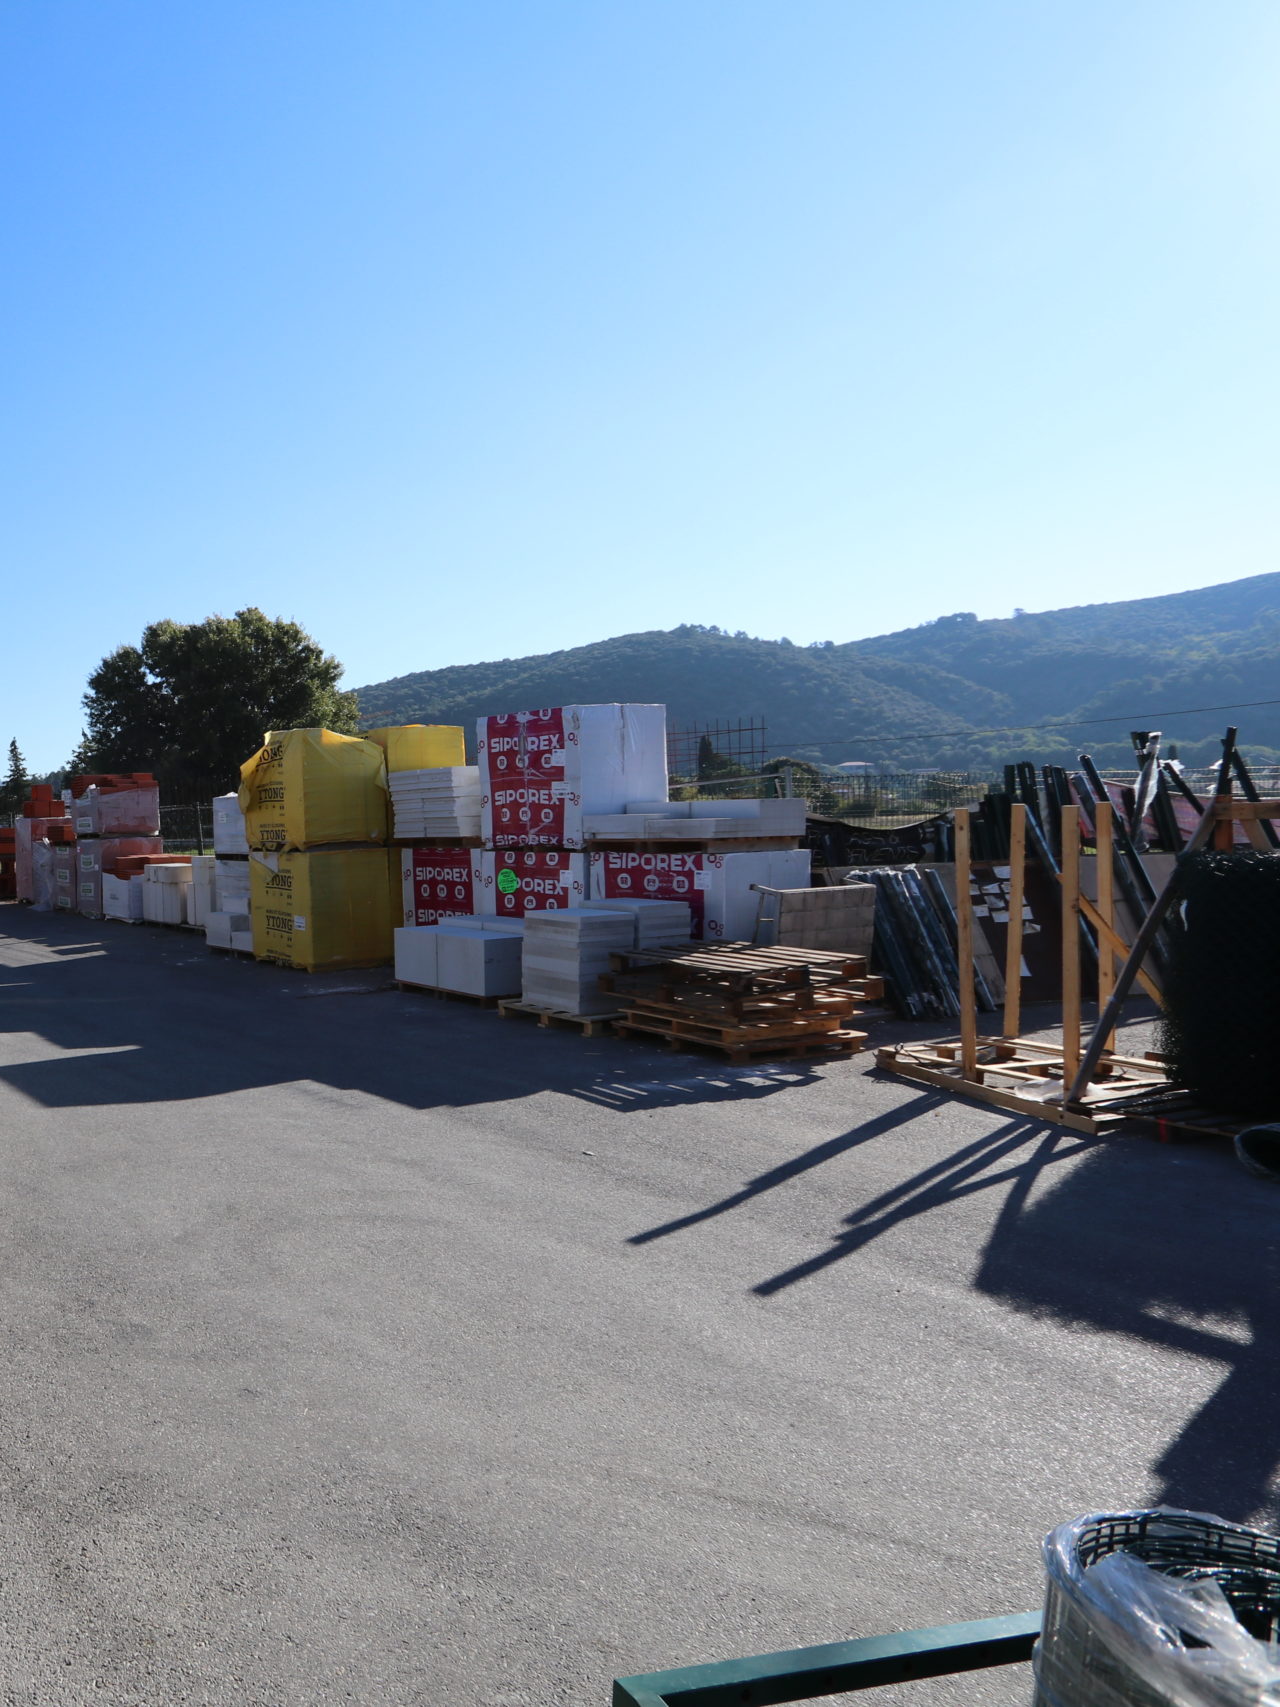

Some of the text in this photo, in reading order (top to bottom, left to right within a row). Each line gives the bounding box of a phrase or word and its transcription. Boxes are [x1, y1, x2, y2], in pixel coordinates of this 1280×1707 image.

[259, 745, 283, 763] ONG
[258, 787, 285, 801] YTONG
[495, 789, 560, 806] SIPOREX
[260, 829, 286, 842] YTONG
[609, 852, 697, 871] SIPOREX
[266, 873, 292, 888] TONG
[415, 866, 469, 882] SIPOREX
[517, 877, 564, 895] OREX
[266, 915, 292, 931] YTONG
[417, 908, 470, 923] SIPO
